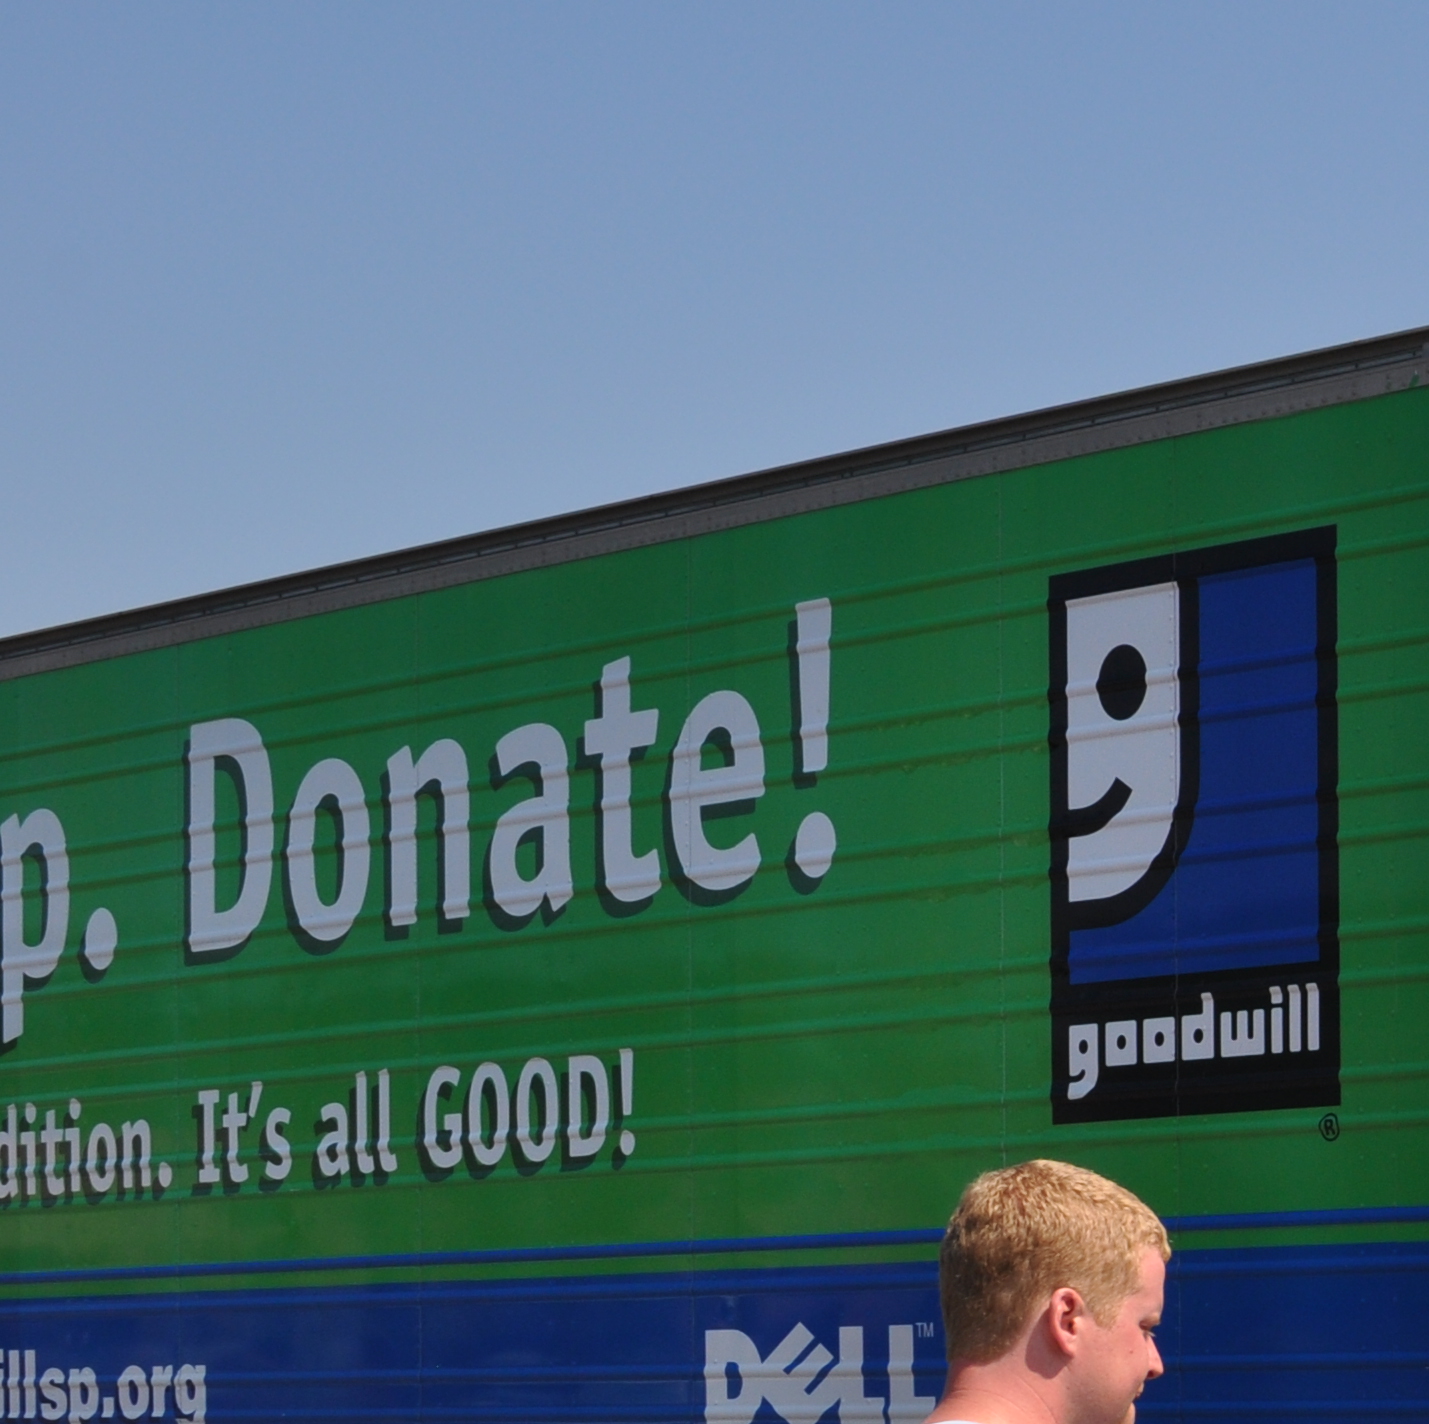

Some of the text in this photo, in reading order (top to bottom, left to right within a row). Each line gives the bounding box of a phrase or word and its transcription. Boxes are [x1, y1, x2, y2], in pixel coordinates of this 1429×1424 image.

[190, 597, 838, 953] Donate!
[1067, 982, 1321, 1101] goodwill
[198, 1080, 292, 1184] It's
[316, 1068, 398, 1177] all
[423, 1047, 636, 1169] GOOD!
